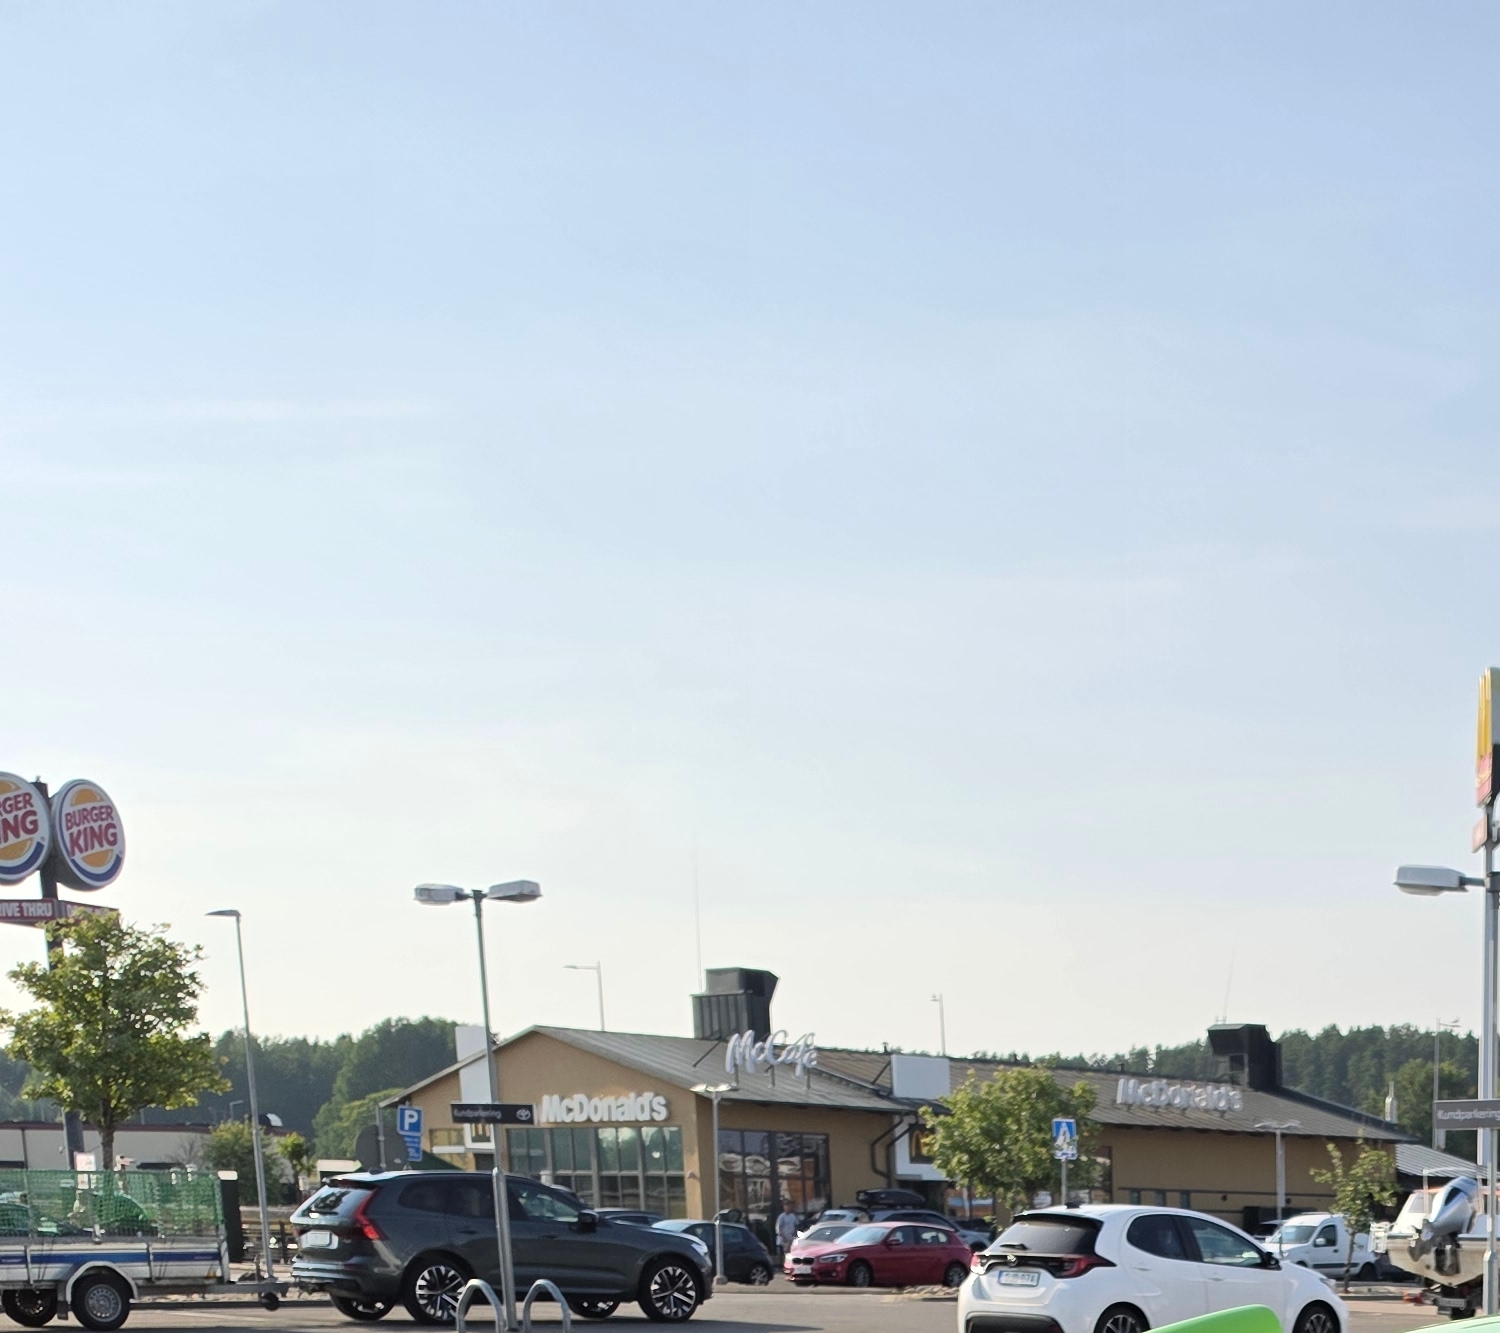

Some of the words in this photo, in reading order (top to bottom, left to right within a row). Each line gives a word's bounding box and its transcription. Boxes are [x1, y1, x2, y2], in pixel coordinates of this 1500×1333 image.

[65, 805, 115, 831] BURGER
[68, 822, 118, 858] KING
[21, 902, 53, 917] THRU
[404, 1109, 418, 1131] P
[541, 1091, 669, 1124] McDonald's
